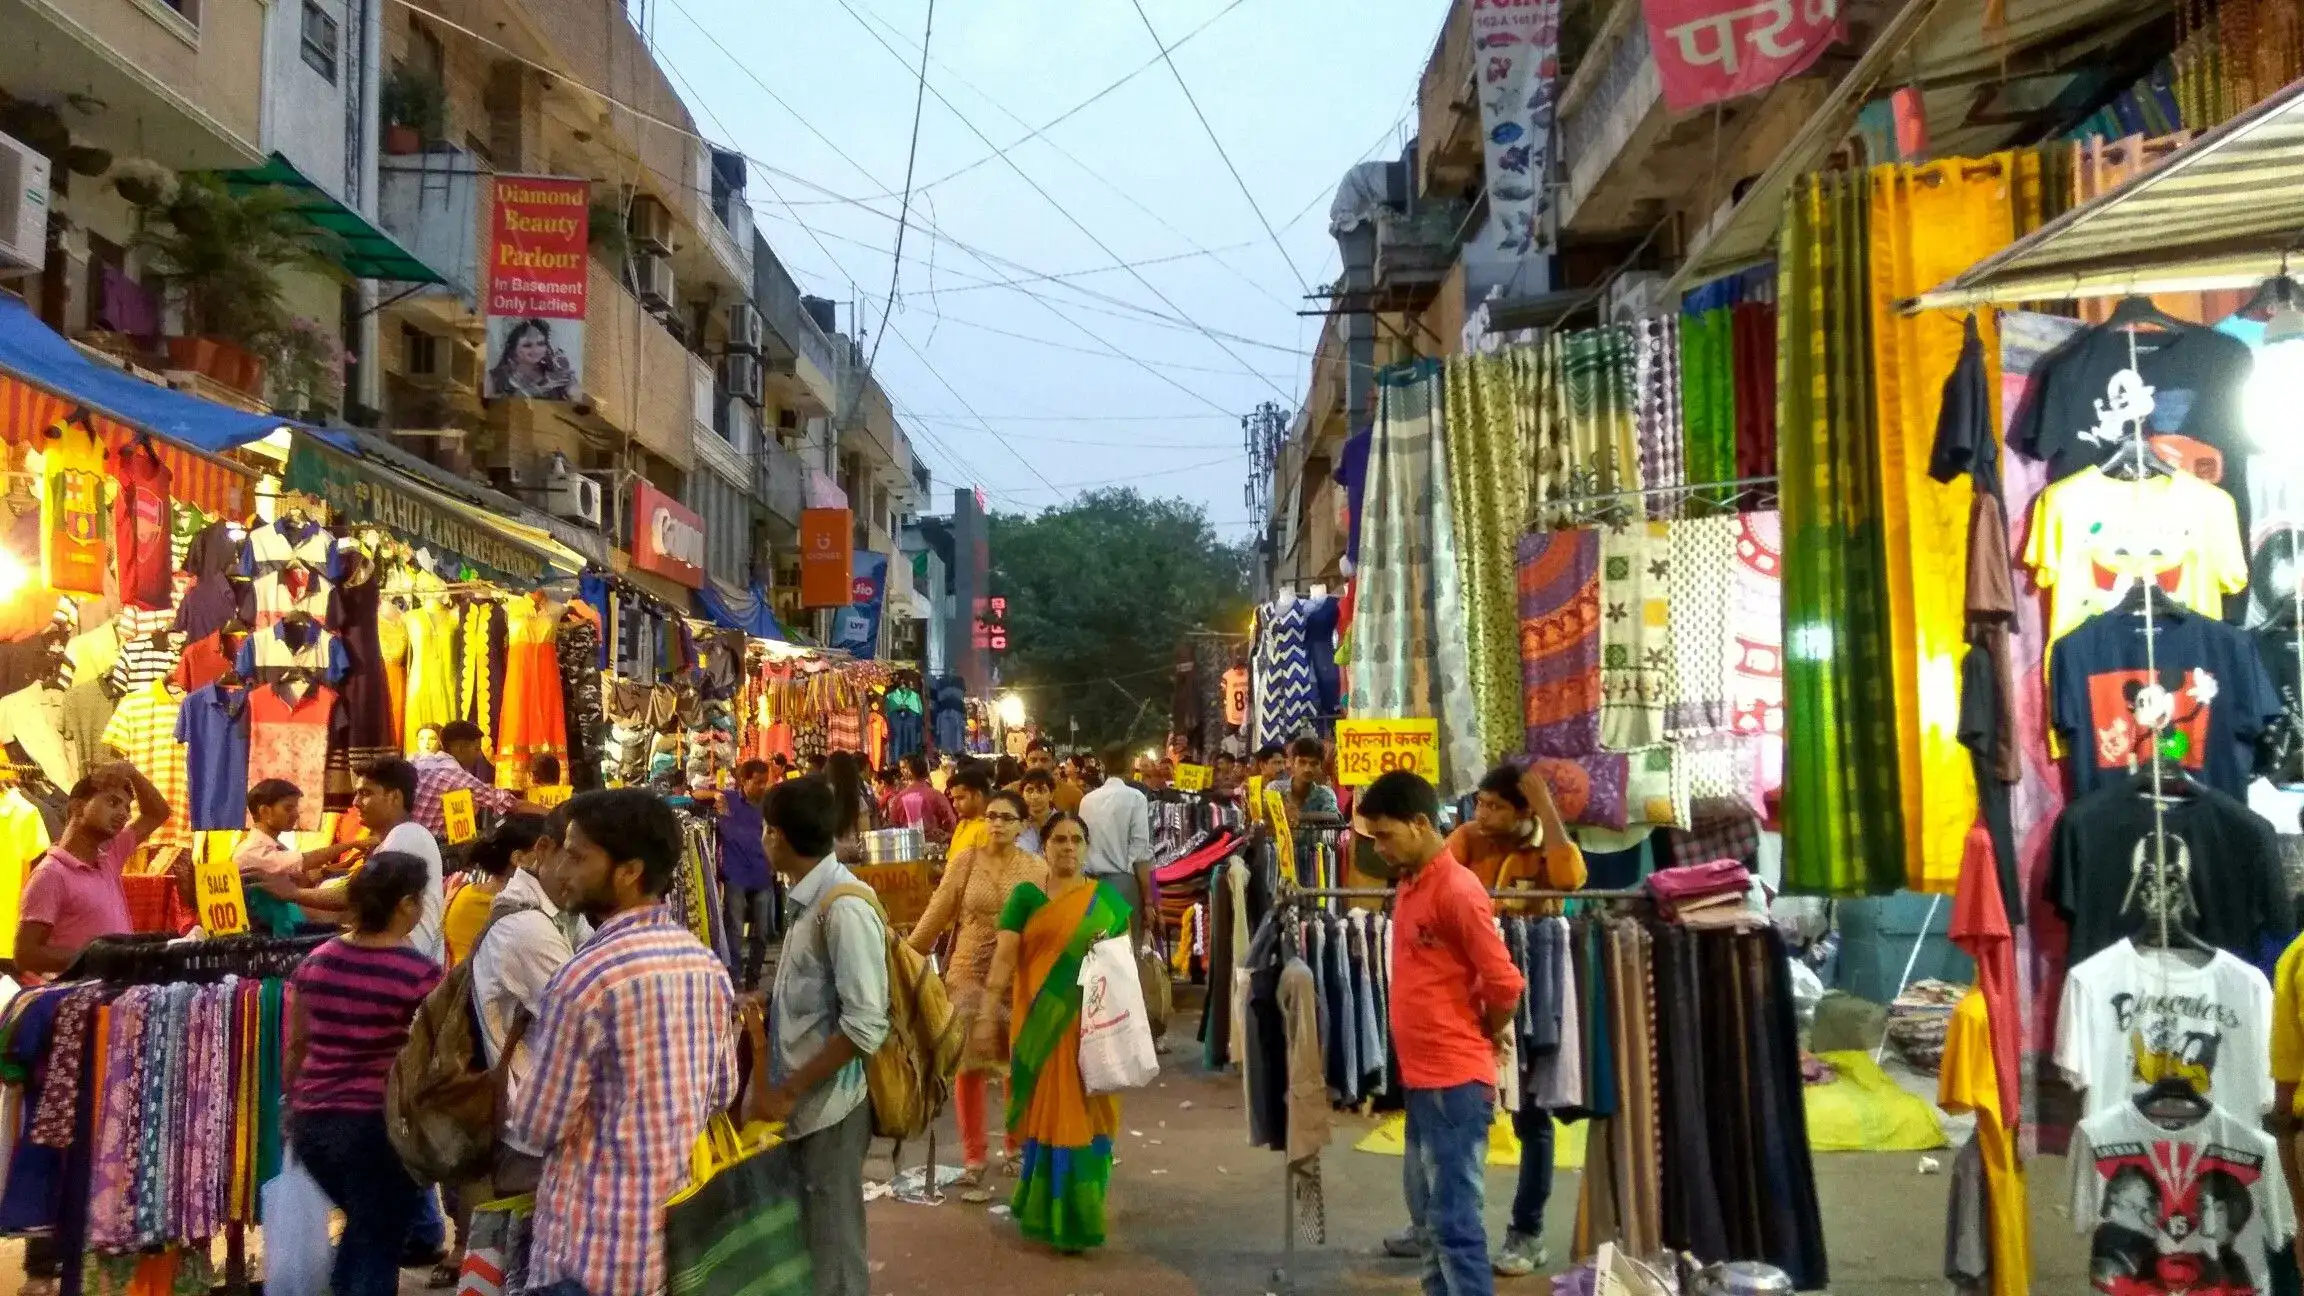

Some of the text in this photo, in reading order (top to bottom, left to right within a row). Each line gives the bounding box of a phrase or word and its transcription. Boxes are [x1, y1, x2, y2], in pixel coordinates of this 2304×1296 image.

[499, 184, 584, 206] Diamond
[504, 208, 579, 241] Beauty
[501, 244, 580, 268] Parlour
[495, 277, 583, 295] In Basement
[494, 295, 577, 313] Only Ladies
[373, 482, 420, 536] BAHU
[853, 582, 873, 596] Jio
[1234, 691, 1244, 712] 8
[1394, 732, 1436, 749] कवर
[1342, 752, 1371, 773] 125
[454, 819, 470, 839] 100
[207, 874, 230, 895] SALE
[209, 902, 238, 931] 100
